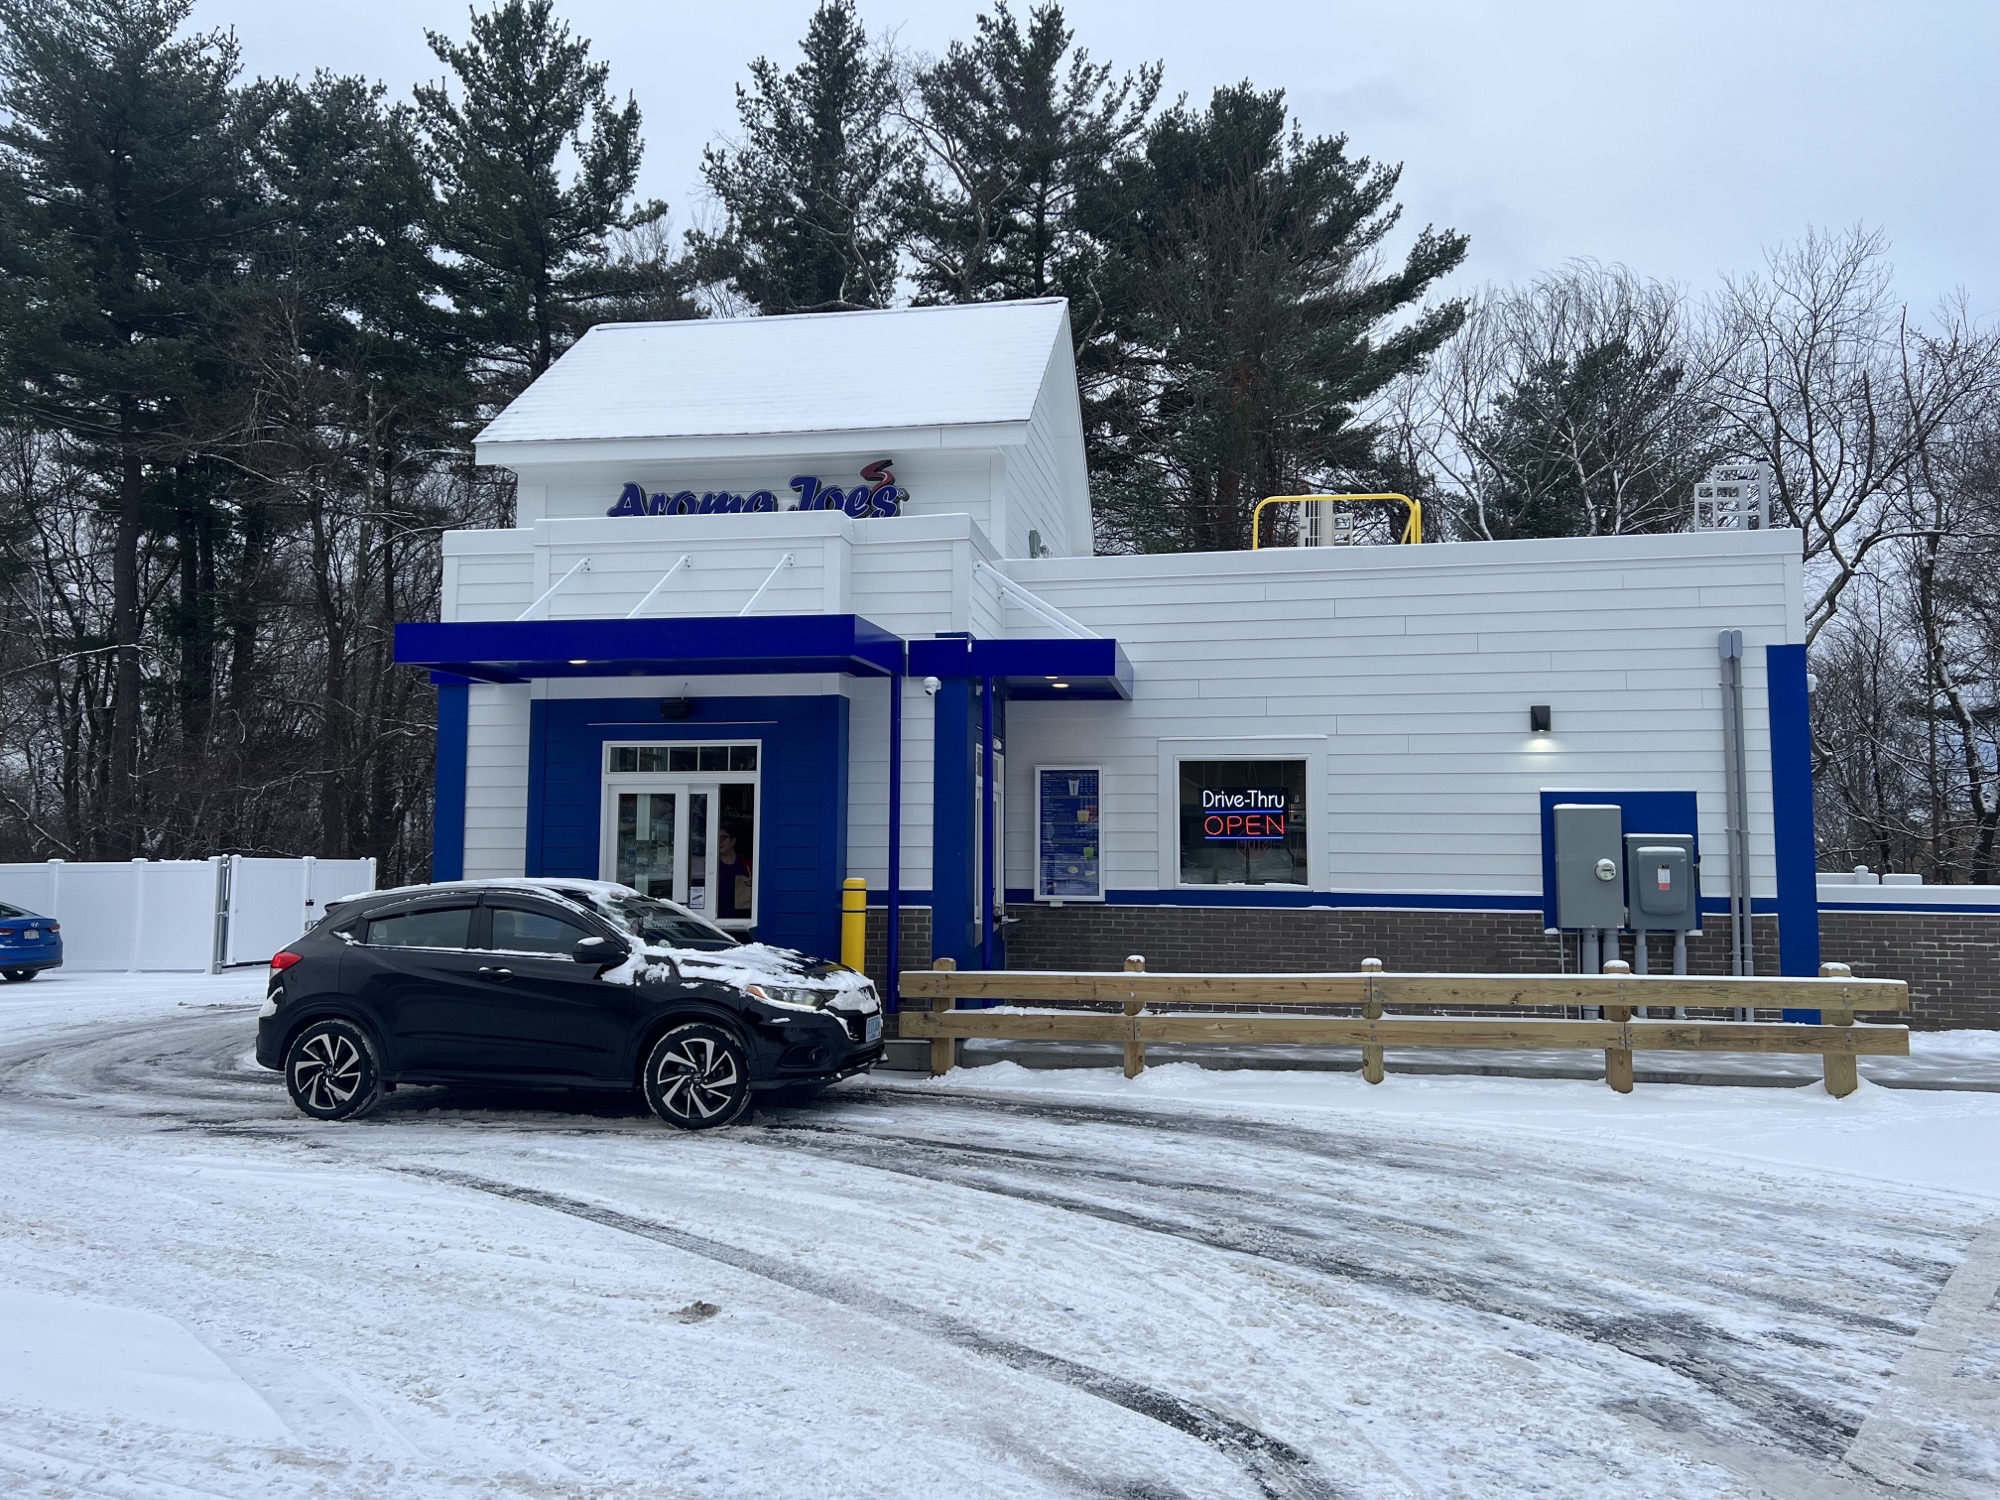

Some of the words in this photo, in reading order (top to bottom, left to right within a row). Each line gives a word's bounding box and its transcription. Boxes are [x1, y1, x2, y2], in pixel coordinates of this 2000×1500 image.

[606, 481, 777, 517] Aroma
[1203, 790, 1285, 808] Drive-Thru
[1204, 815, 1285, 835] OPEN
